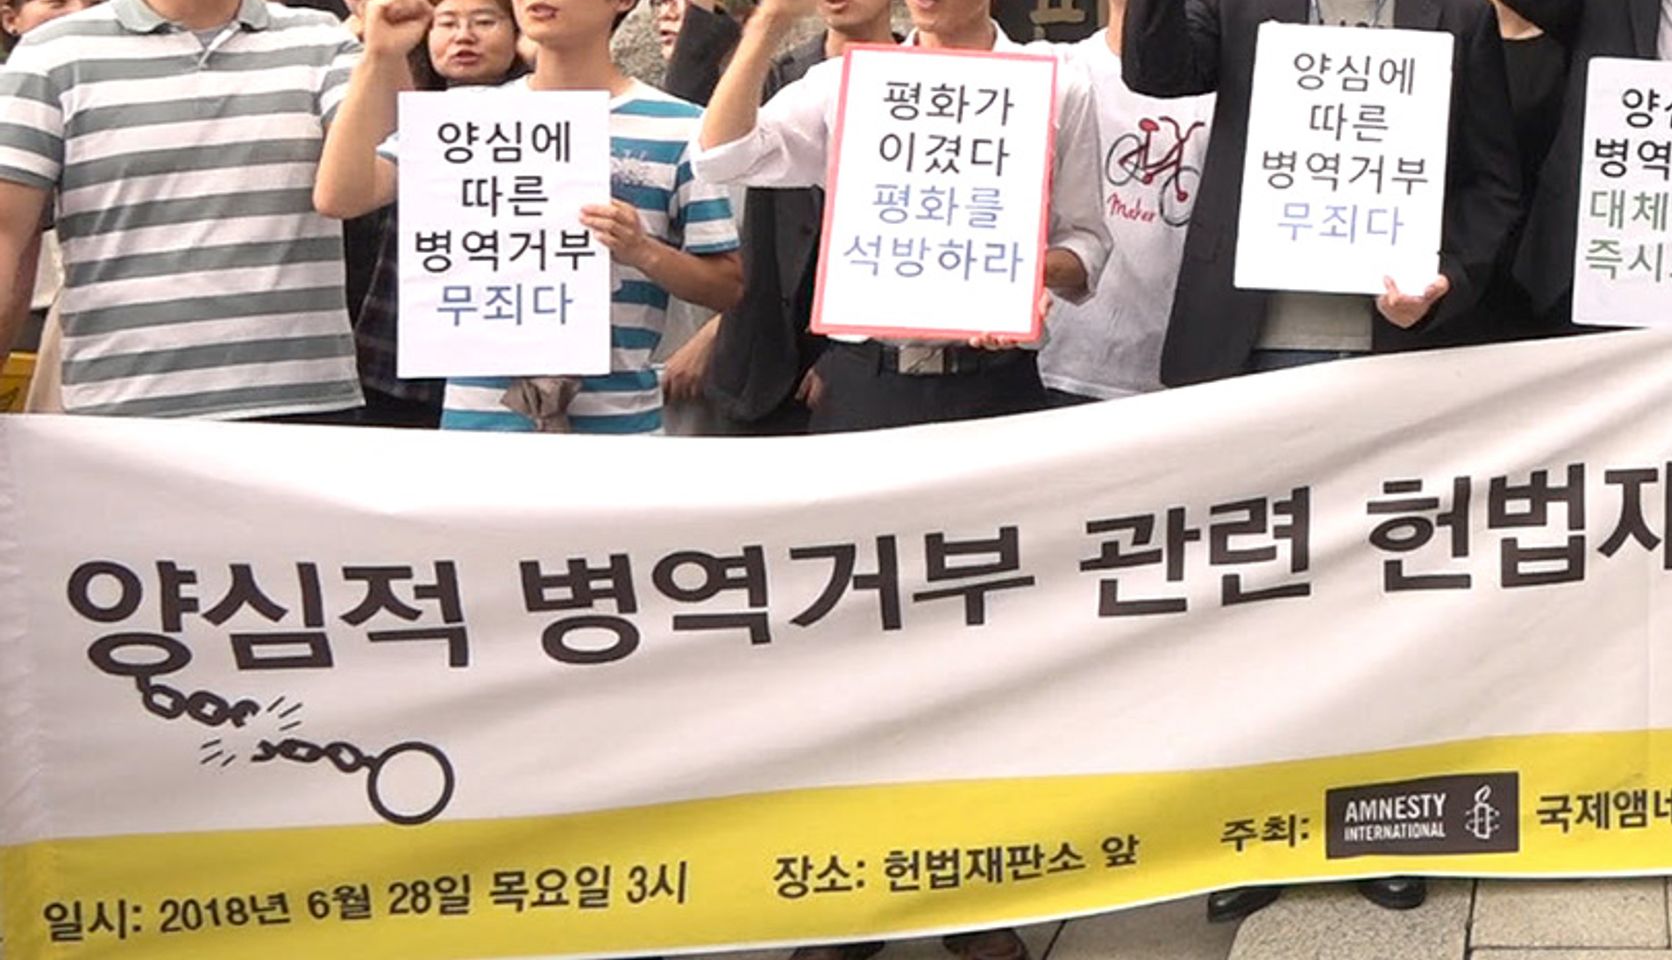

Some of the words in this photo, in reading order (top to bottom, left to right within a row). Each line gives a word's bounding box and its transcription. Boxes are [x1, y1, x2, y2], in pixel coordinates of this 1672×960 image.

[1293, 53, 1415, 95] 양심에
[883, 81, 1014, 126] 평화가
[1309, 103, 1389, 142] 따른
[438, 121, 571, 163] 양심에
[879, 132, 1010, 176] 이겼다
[1262, 150, 1428, 195] 병역거부
[462, 175, 549, 217] 따른
[872, 183, 1004, 228] 평화를
[1277, 202, 1404, 245] 무죄다
[415, 229, 595, 273] 병역거부
[843, 235, 1024, 283] 석방하라
[436, 282, 573, 326] 무죄다
[66, 560, 470, 677] 양심적
[519, 526, 1035, 664] 병역거부
[1079, 485, 1312, 617] 관련
[1345, 793, 1447, 823] AMNESTY
[1220, 814, 1310, 851] 주최:
[1344, 821, 1447, 842] INTERNATIONAL
[773, 855, 865, 899] 장소:
[884, 842, 1086, 891] 헌법재판소
[1100, 834, 1139, 869] 앞
[43, 898, 141, 942] 일시:
[159, 892, 290, 933] 2018년
[307, 883, 371, 920] 6월
[388, 873, 471, 915] 28일
[489, 865, 611, 913] 목요일
[627, 861, 687, 904] 3시
